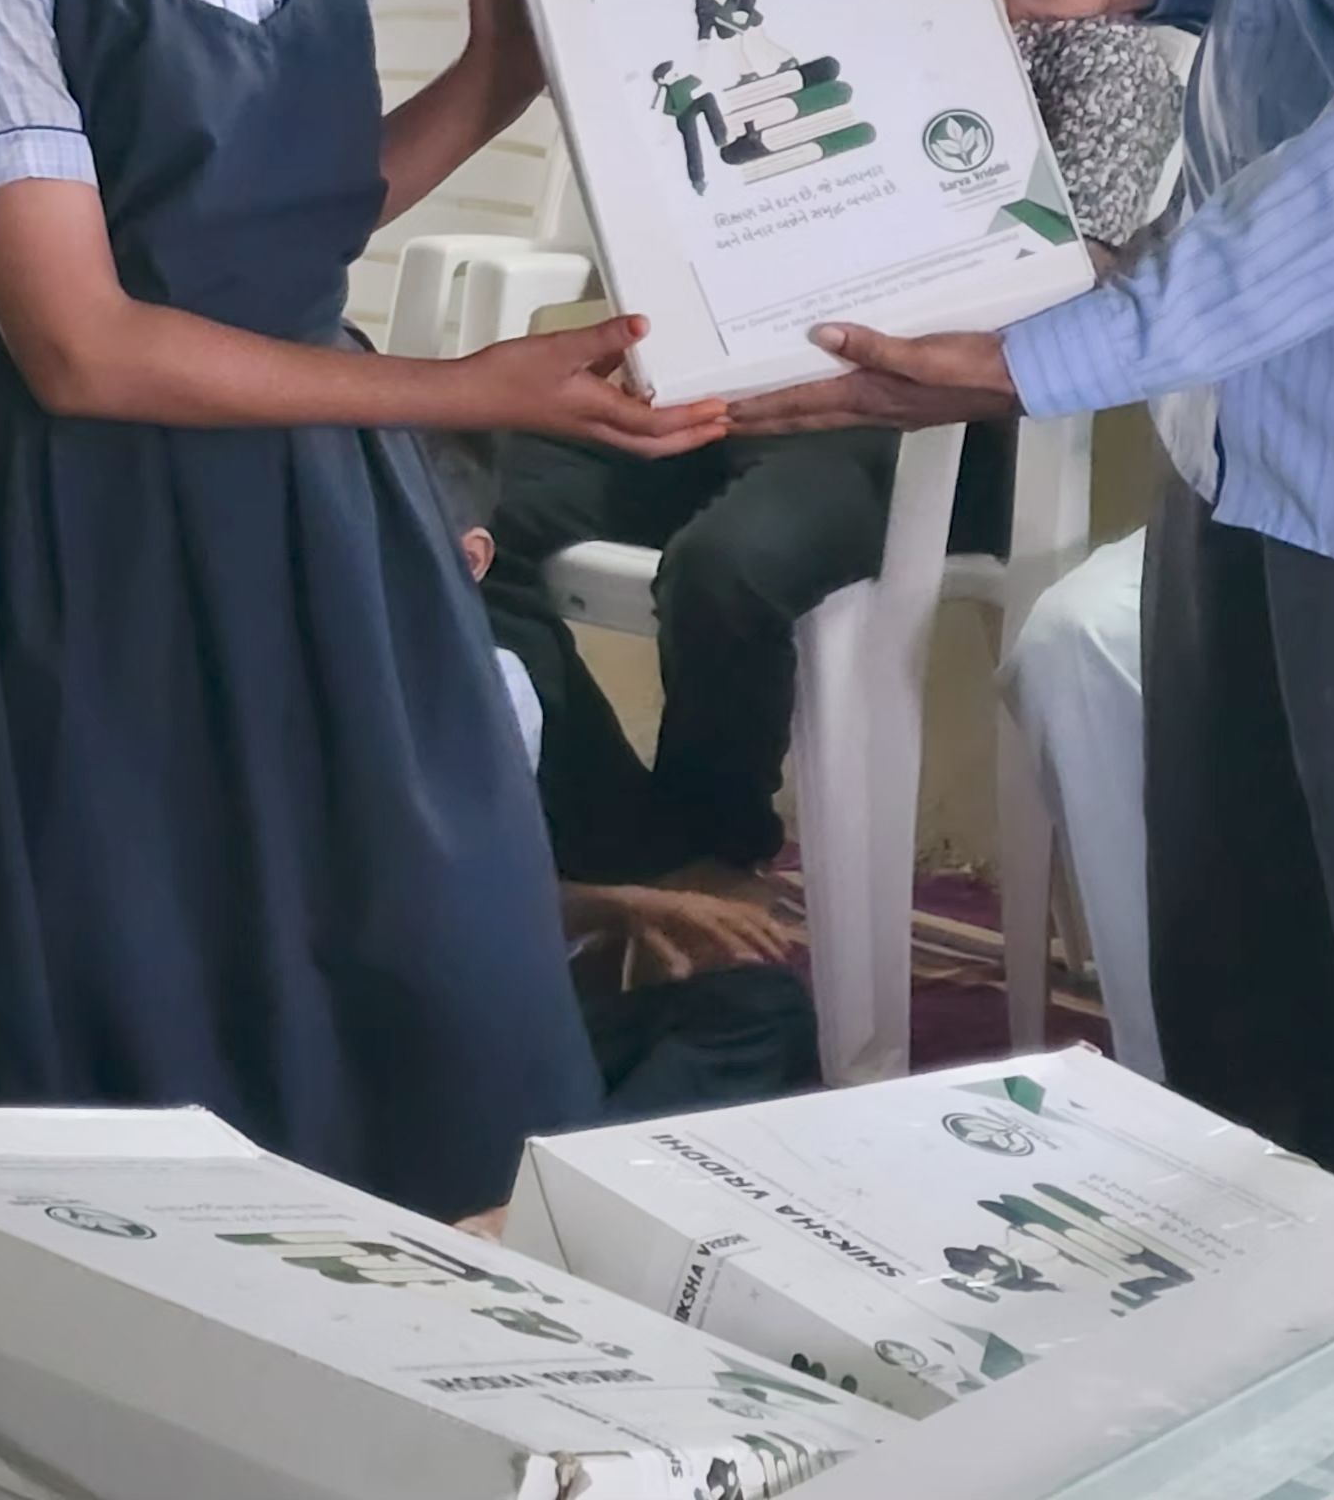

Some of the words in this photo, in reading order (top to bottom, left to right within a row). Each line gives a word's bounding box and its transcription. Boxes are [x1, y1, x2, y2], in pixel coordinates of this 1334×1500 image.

[650, 1133, 771, 1200] VRIDDHI
[774, 1204, 906, 1279] SHIKSHA
[673, 1264, 706, 1324] IKSHA
